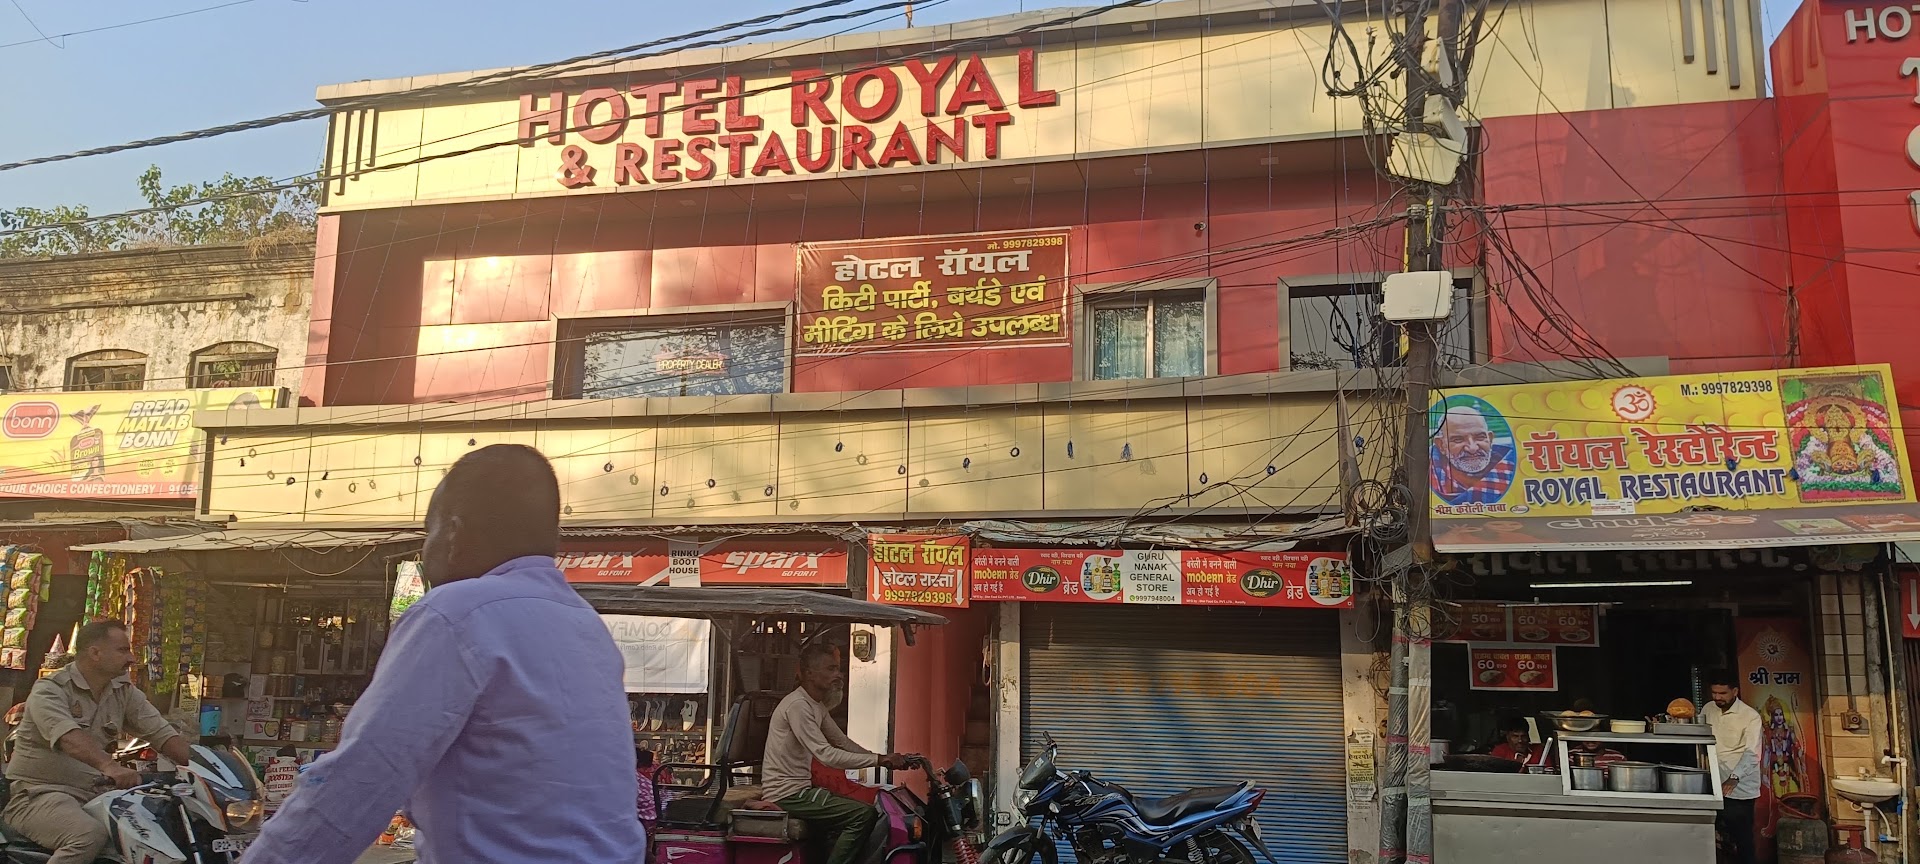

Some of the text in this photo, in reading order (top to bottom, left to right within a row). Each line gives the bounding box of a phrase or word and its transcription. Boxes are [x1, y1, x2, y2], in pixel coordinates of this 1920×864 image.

[1845, 5, 1920, 43] HO
[519, 48, 1058, 147] HOTEL ROYAL
[557, 112, 1011, 189] & RESTAURANT
[1003, 237, 1063, 249] 9997829398
[832, 248, 1032, 282] होटल रॉयल
[822, 283, 877, 312] किटी
[883, 280, 938, 309] पार्टी,
[1010, 275, 1046, 304] एवं
[804, 311, 1060, 344] मीटिंग के लिये उपलब्ध
[658, 359, 723, 370] PROPERTY DEALER
[1702, 380, 1773, 395] 9997829398
[129, 399, 190, 418] BREAD
[11, 408, 52, 429] bonn
[117, 414, 191, 433] MATLAB
[119, 431, 178, 449] BONN
[74, 445, 100, 459] Brown
[1523, 431, 1628, 472] रॉयल
[29, 483, 67, 494] CHOICE
[69, 483, 159, 495] CONFECTIONERY
[1524, 468, 1786, 505] ROYAL RESTAURANT
[872, 537, 965, 565] होटल रॉयल
[1137, 553, 1164, 561] GURU
[722, 548, 833, 574] sparx
[1134, 563, 1167, 571] NANAK
[881, 567, 917, 587] होटल
[1028, 572, 1056, 585] Dhir
[1130, 573, 1174, 581] GENERAL
[1247, 575, 1278, 590] Dhir
[884, 590, 953, 604] 9997829398
[1471, 614, 1488, 623] 50
[1518, 615, 1536, 625] 60
[1558, 616, 1576, 625] 60
[1477, 660, 1495, 669] 60
[1517, 660, 1535, 670] 60
[1749, 666, 1800, 685] श्री राम
